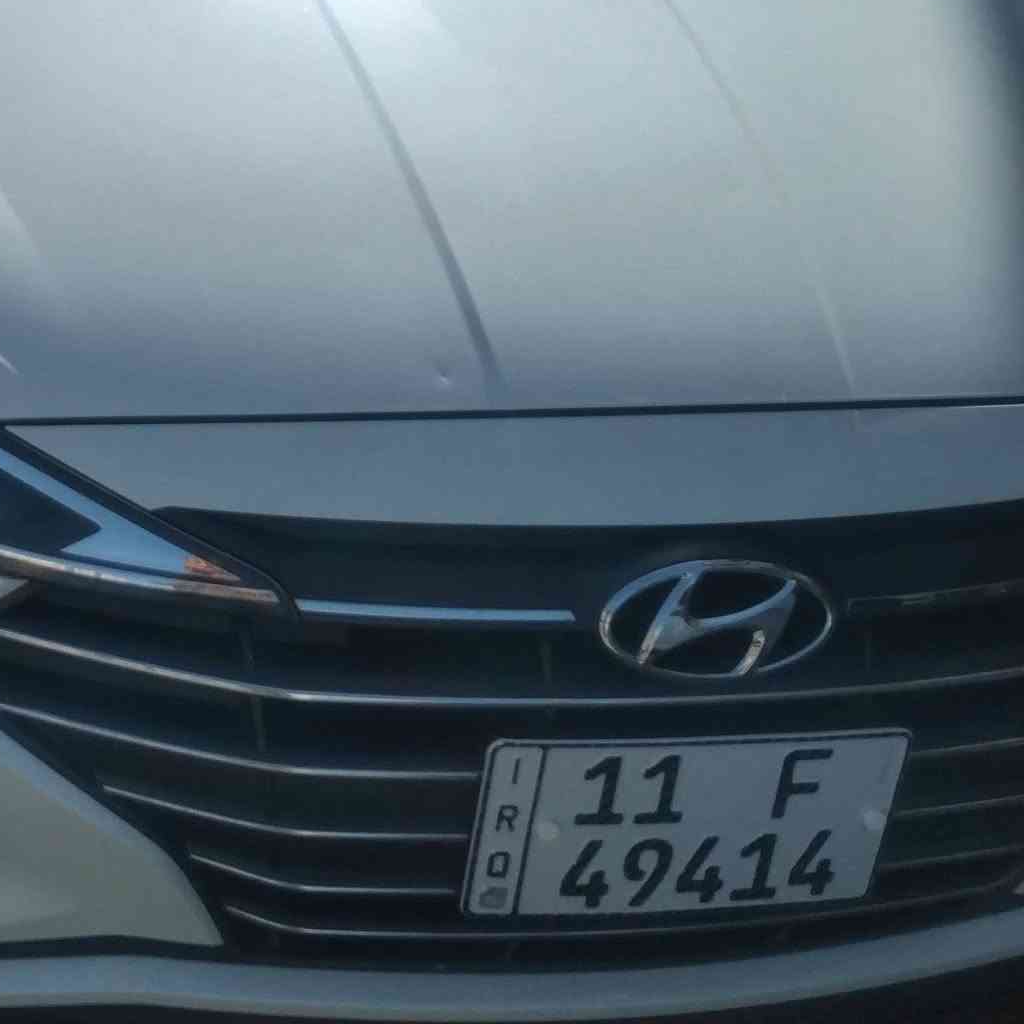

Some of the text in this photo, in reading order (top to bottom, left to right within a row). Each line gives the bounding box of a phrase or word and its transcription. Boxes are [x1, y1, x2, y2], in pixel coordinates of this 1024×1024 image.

[574, 748, 834, 826] 11 F
[560, 829, 836, 908] 49414
